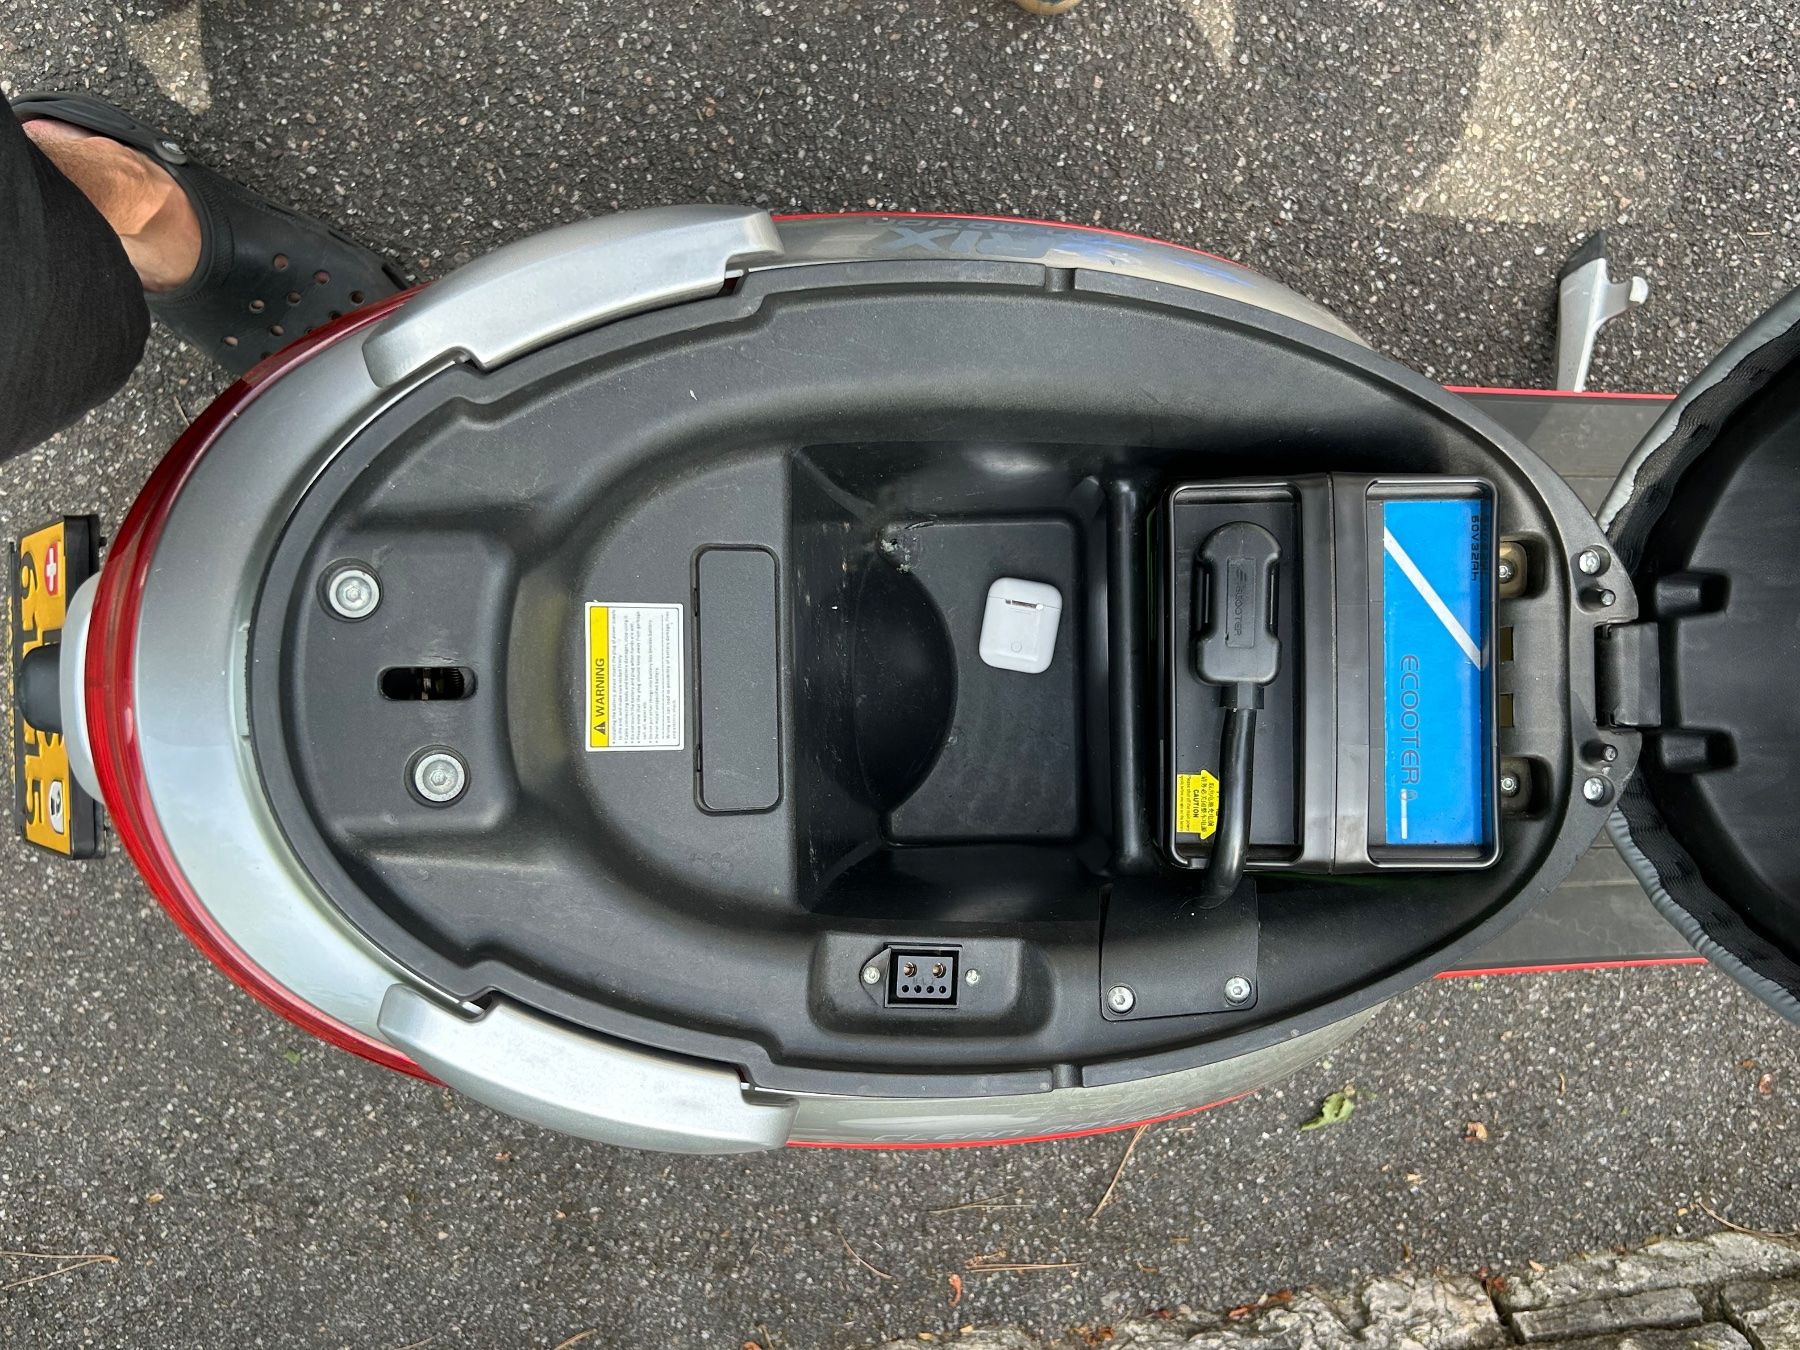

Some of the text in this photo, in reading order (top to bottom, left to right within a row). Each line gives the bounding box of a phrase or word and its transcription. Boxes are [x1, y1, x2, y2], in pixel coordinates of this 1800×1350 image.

[1471, 515, 1480, 581] 60V32Ah
[18, 551, 42, 826] 6115
[596, 658, 605, 717] WARNING
[1400, 655, 1420, 785] ECOOTER
